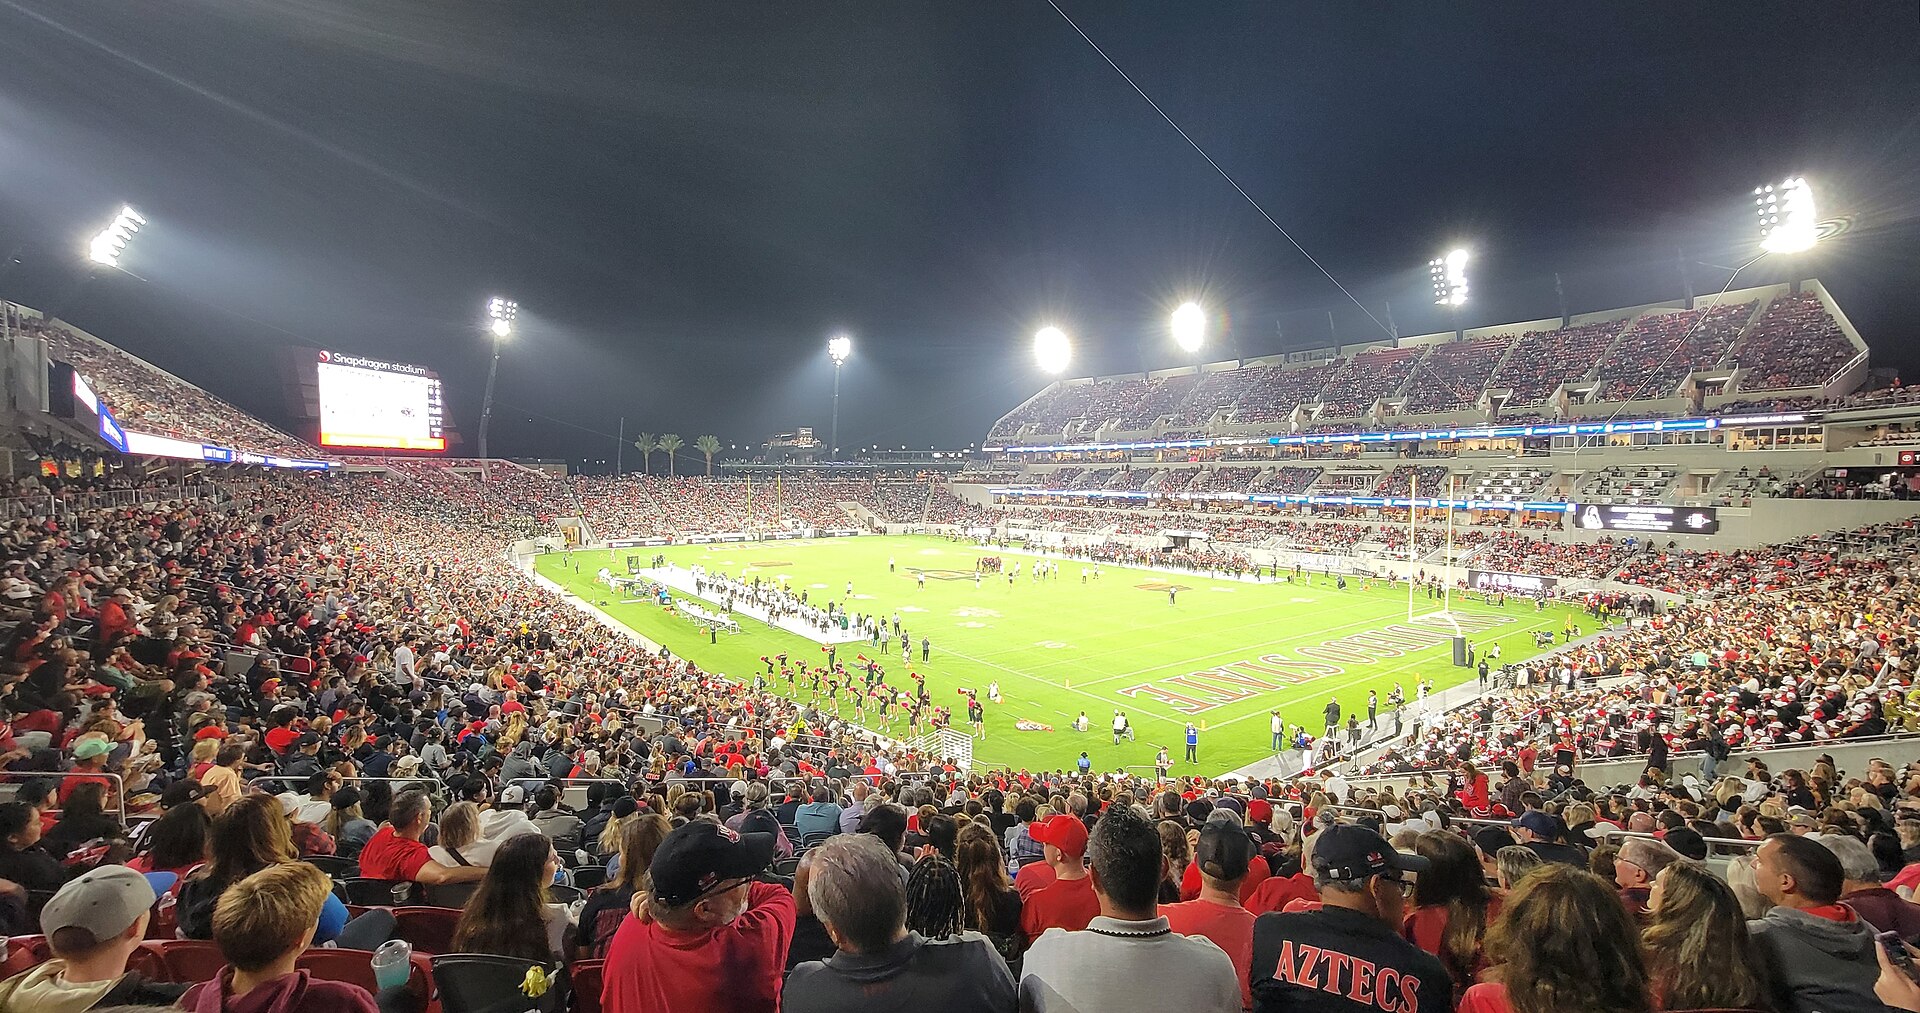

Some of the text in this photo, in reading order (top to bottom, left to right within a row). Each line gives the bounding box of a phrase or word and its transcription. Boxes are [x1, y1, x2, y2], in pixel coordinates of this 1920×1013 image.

[333, 353, 425, 375] Snapdragon stadium
[1117, 653, 1346, 716] STATE
[1272, 940, 1422, 1013] AZTECS
